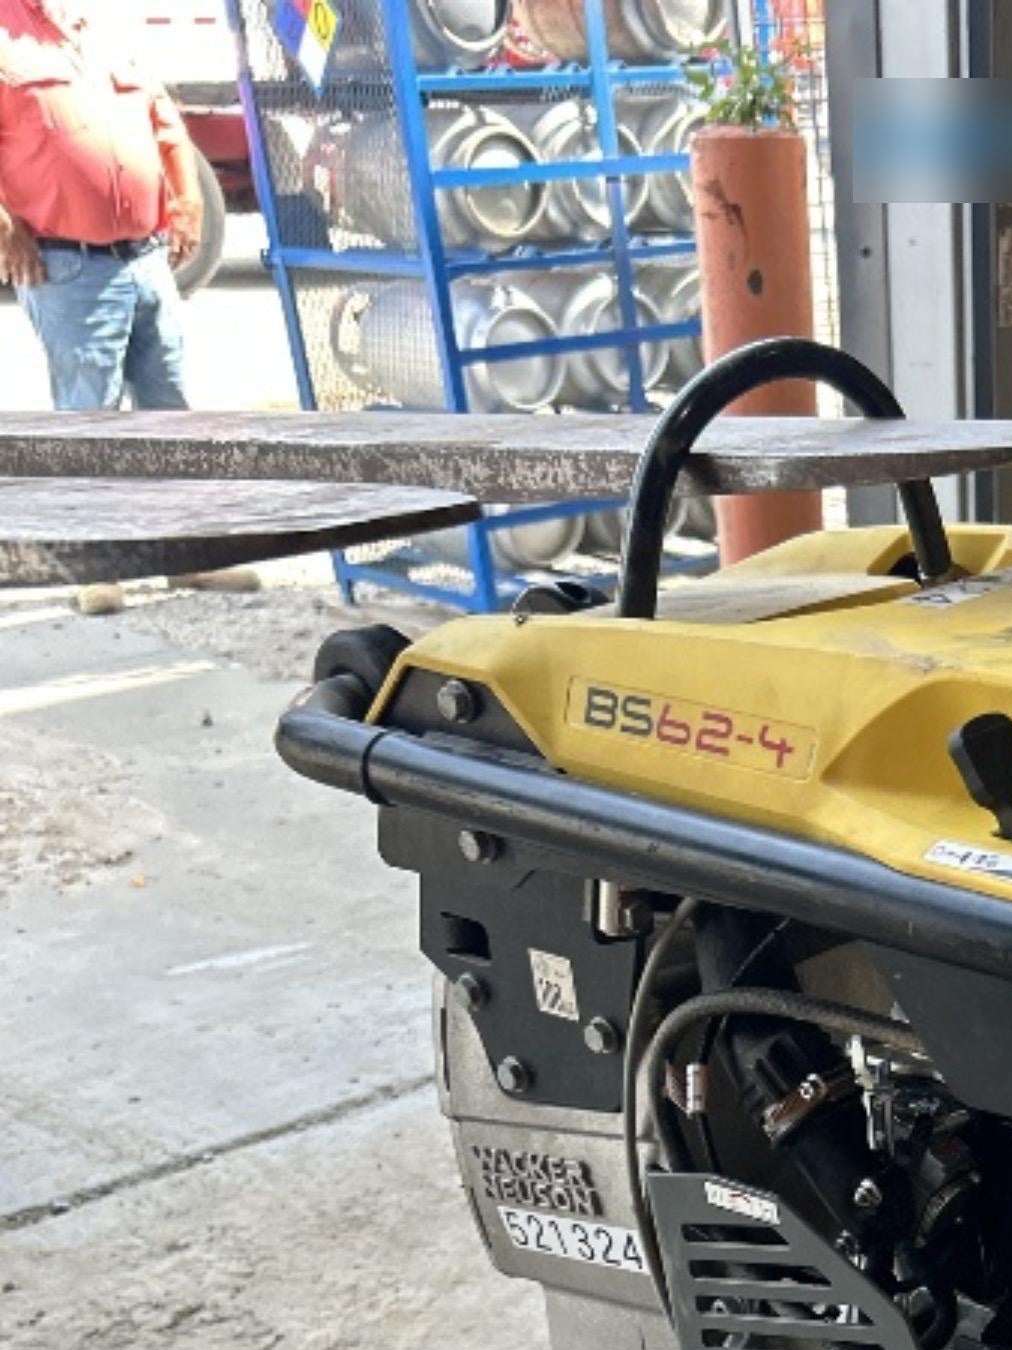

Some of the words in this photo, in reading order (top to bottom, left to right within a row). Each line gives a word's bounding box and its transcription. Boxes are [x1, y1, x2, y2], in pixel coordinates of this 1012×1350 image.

[584, 687, 795, 769] BS62-4
[472, 1144, 596, 1188] WACKER
[482, 1174, 604, 1216] NEUSON
[503, 1210, 643, 1270] 521324
